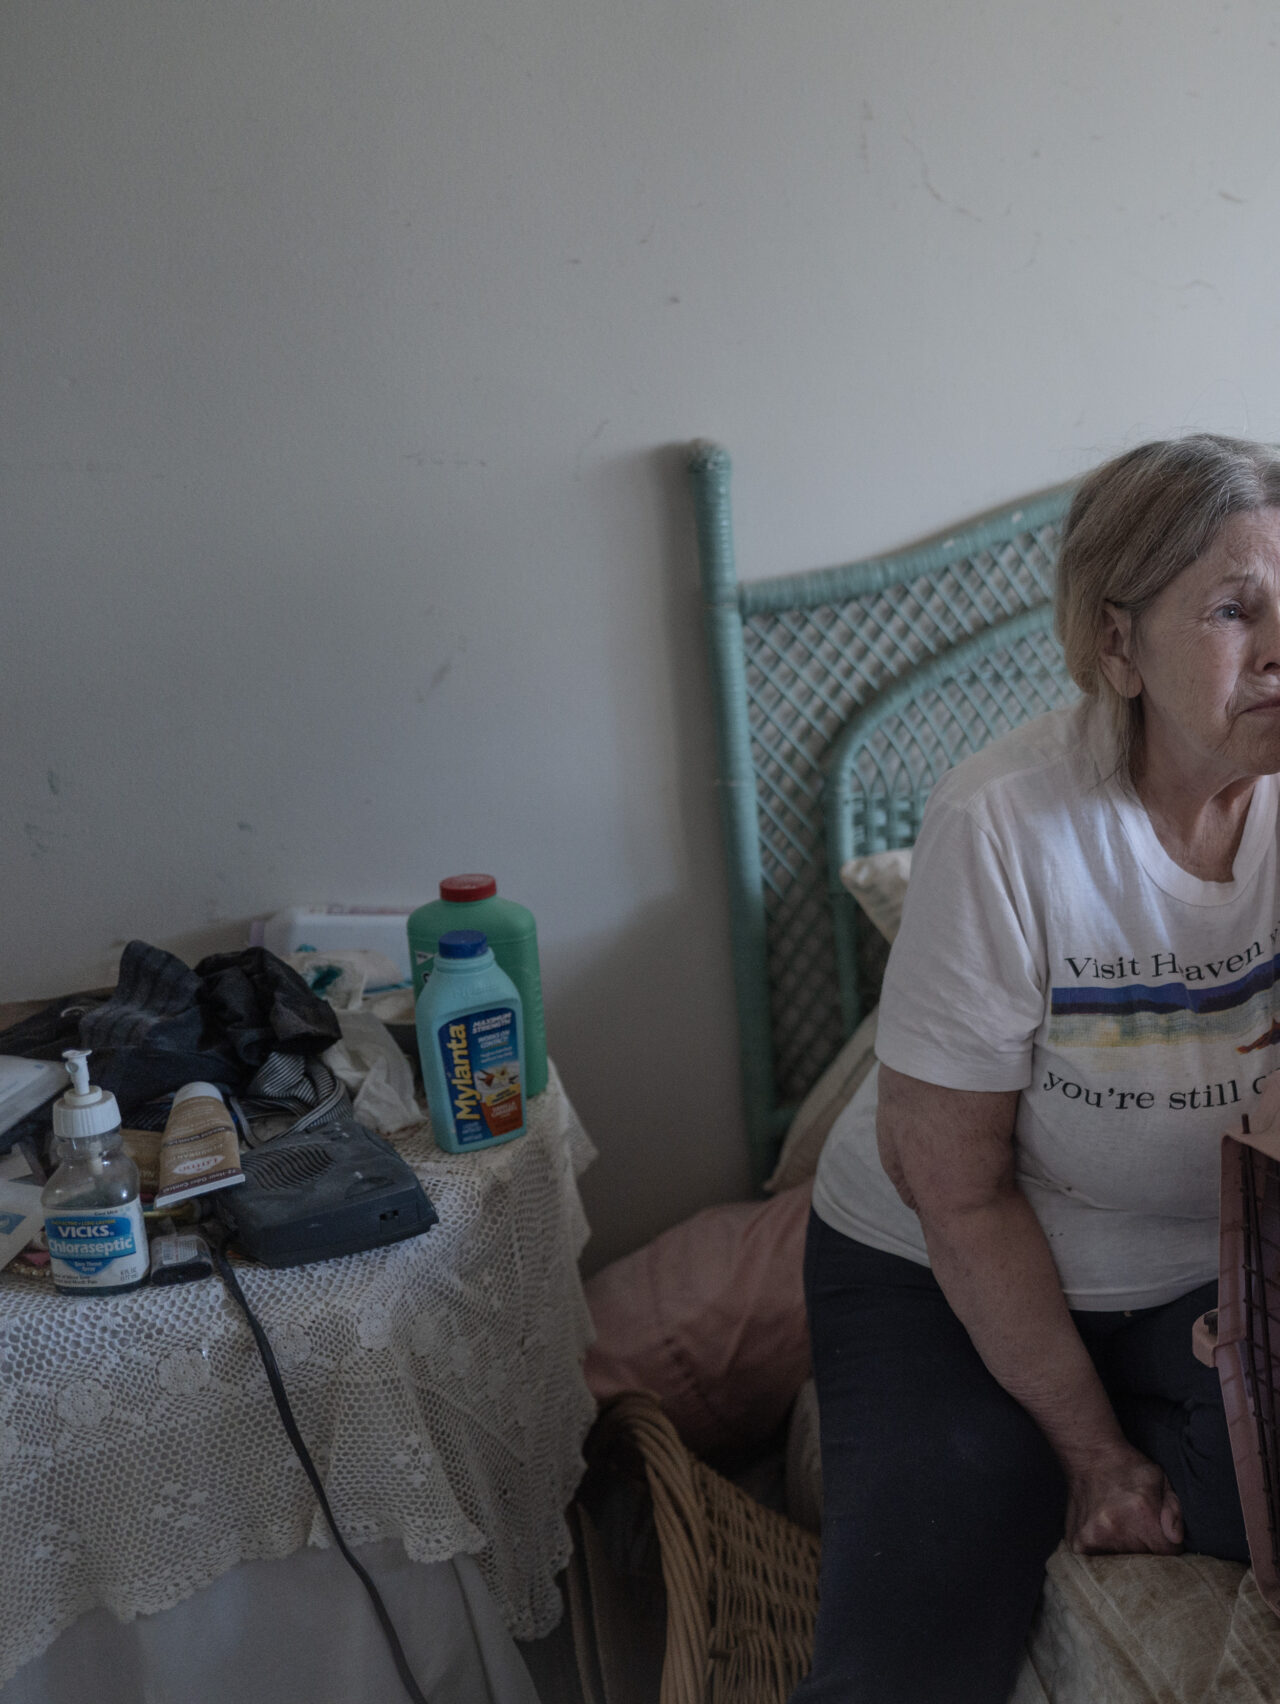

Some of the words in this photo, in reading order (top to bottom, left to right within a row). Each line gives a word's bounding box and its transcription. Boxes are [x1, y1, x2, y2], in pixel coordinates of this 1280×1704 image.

[1064, 957, 1141, 980] Visit
[1152, 941, 1265, 982] Haven
[446, 1023, 482, 1120] Mylanta
[1043, 1071, 1156, 1110] you're
[1168, 1079, 1243, 1110] still
[48, 1237, 132, 1256] Chloraseptic
[57, 1225, 109, 1238] VICKS
